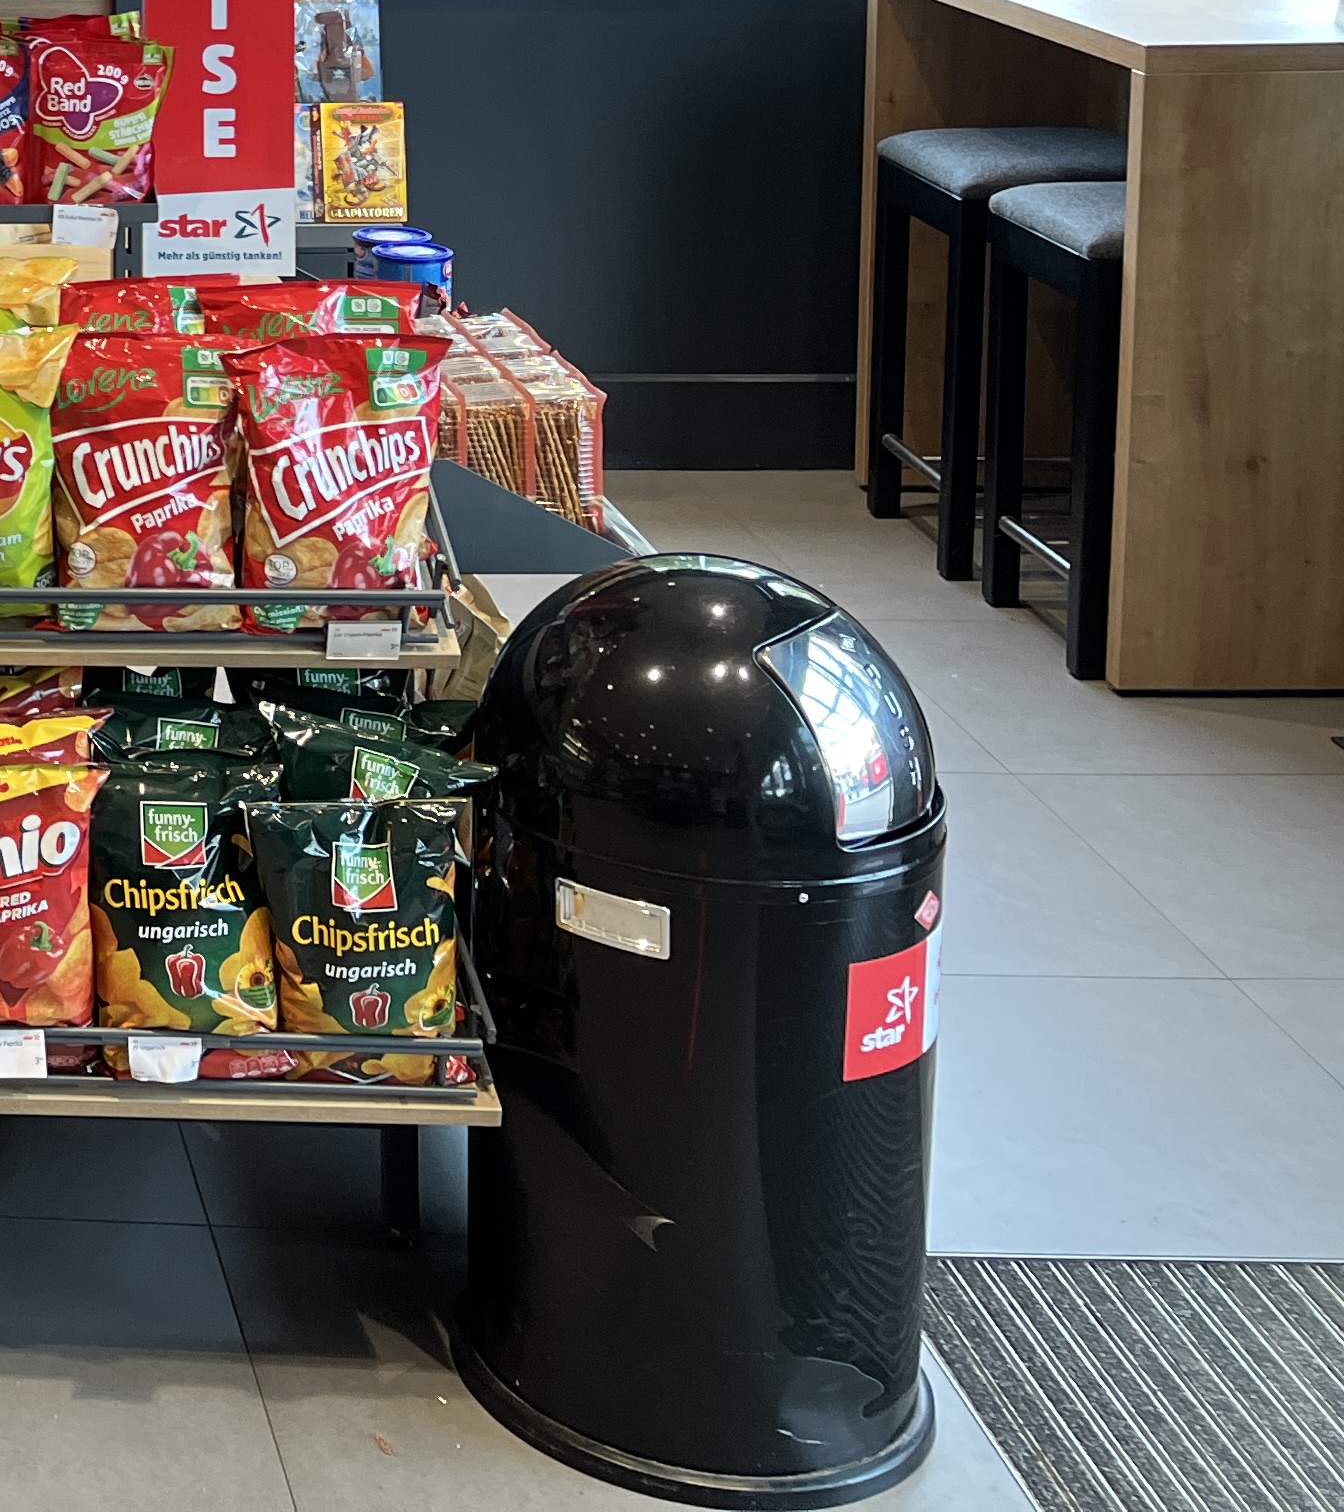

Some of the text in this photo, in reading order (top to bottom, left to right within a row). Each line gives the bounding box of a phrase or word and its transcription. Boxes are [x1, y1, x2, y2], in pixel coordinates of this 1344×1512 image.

[158, 213, 227, 238] star
[158, 250, 282, 263] Mehr als günstig tanken!
[57, 366, 158, 410] Lorenz
[72, 424, 220, 509] Crunchips
[271, 429, 421, 522] Crunchips
[130, 492, 196, 534] Paprika
[332, 495, 395, 542] Paprika
[164, 725, 208, 746] funny-
[360, 754, 402, 778] funny-
[148, 810, 196, 831] funny-
[155, 823, 198, 843] frisch
[346, 866, 386, 886] frisch
[0, 891, 31, 909] RED
[104, 874, 246, 916] Chipsfrisch
[138, 918, 229, 942] ungarisch
[292, 914, 440, 957] Chipsfrisch
[324, 958, 417, 982] ungarisch
[861, 1023, 906, 1052] star
